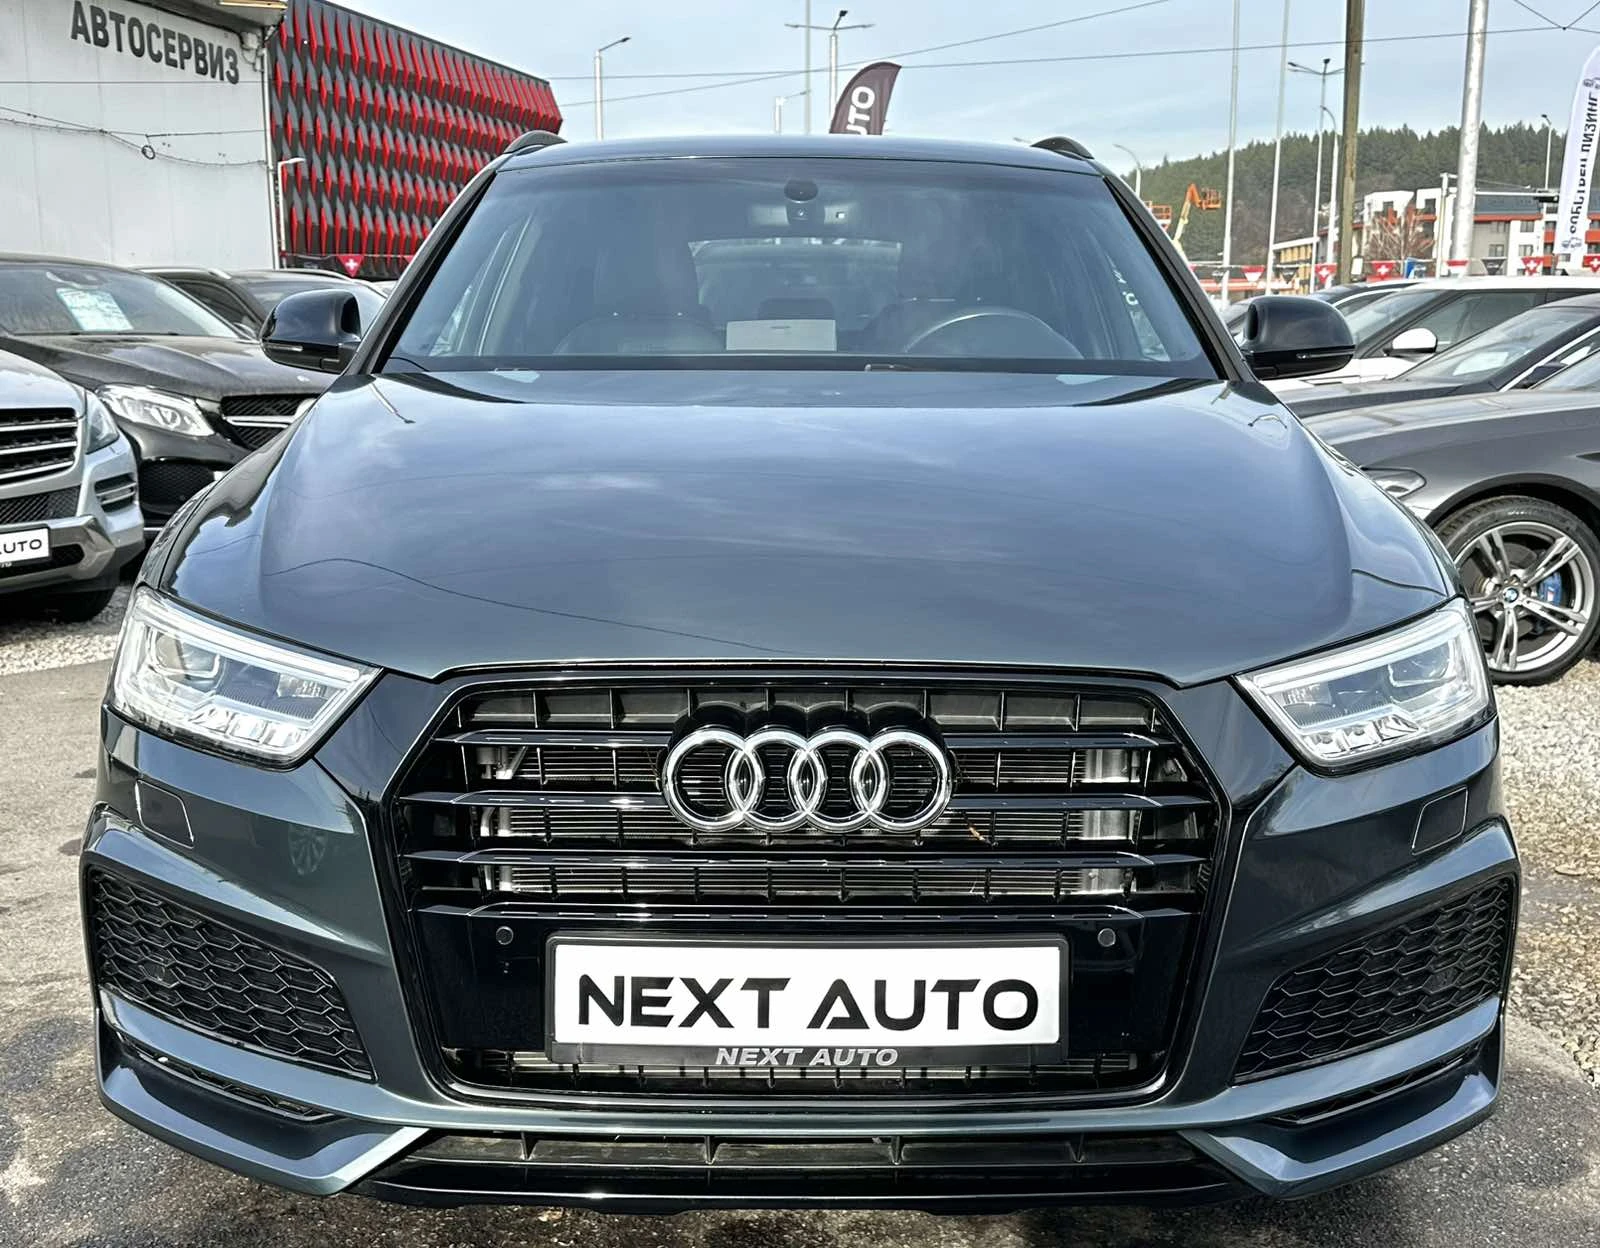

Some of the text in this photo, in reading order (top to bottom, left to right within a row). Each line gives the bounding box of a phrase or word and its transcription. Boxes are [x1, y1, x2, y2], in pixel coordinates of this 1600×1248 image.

[70, 1, 240, 84] АВТОСЕРВИЗ
[0, 539, 42, 555] UTO
[578, 974, 1039, 1031] NEXT AUTO
[715, 1047, 899, 1066] NEXT AUTO
